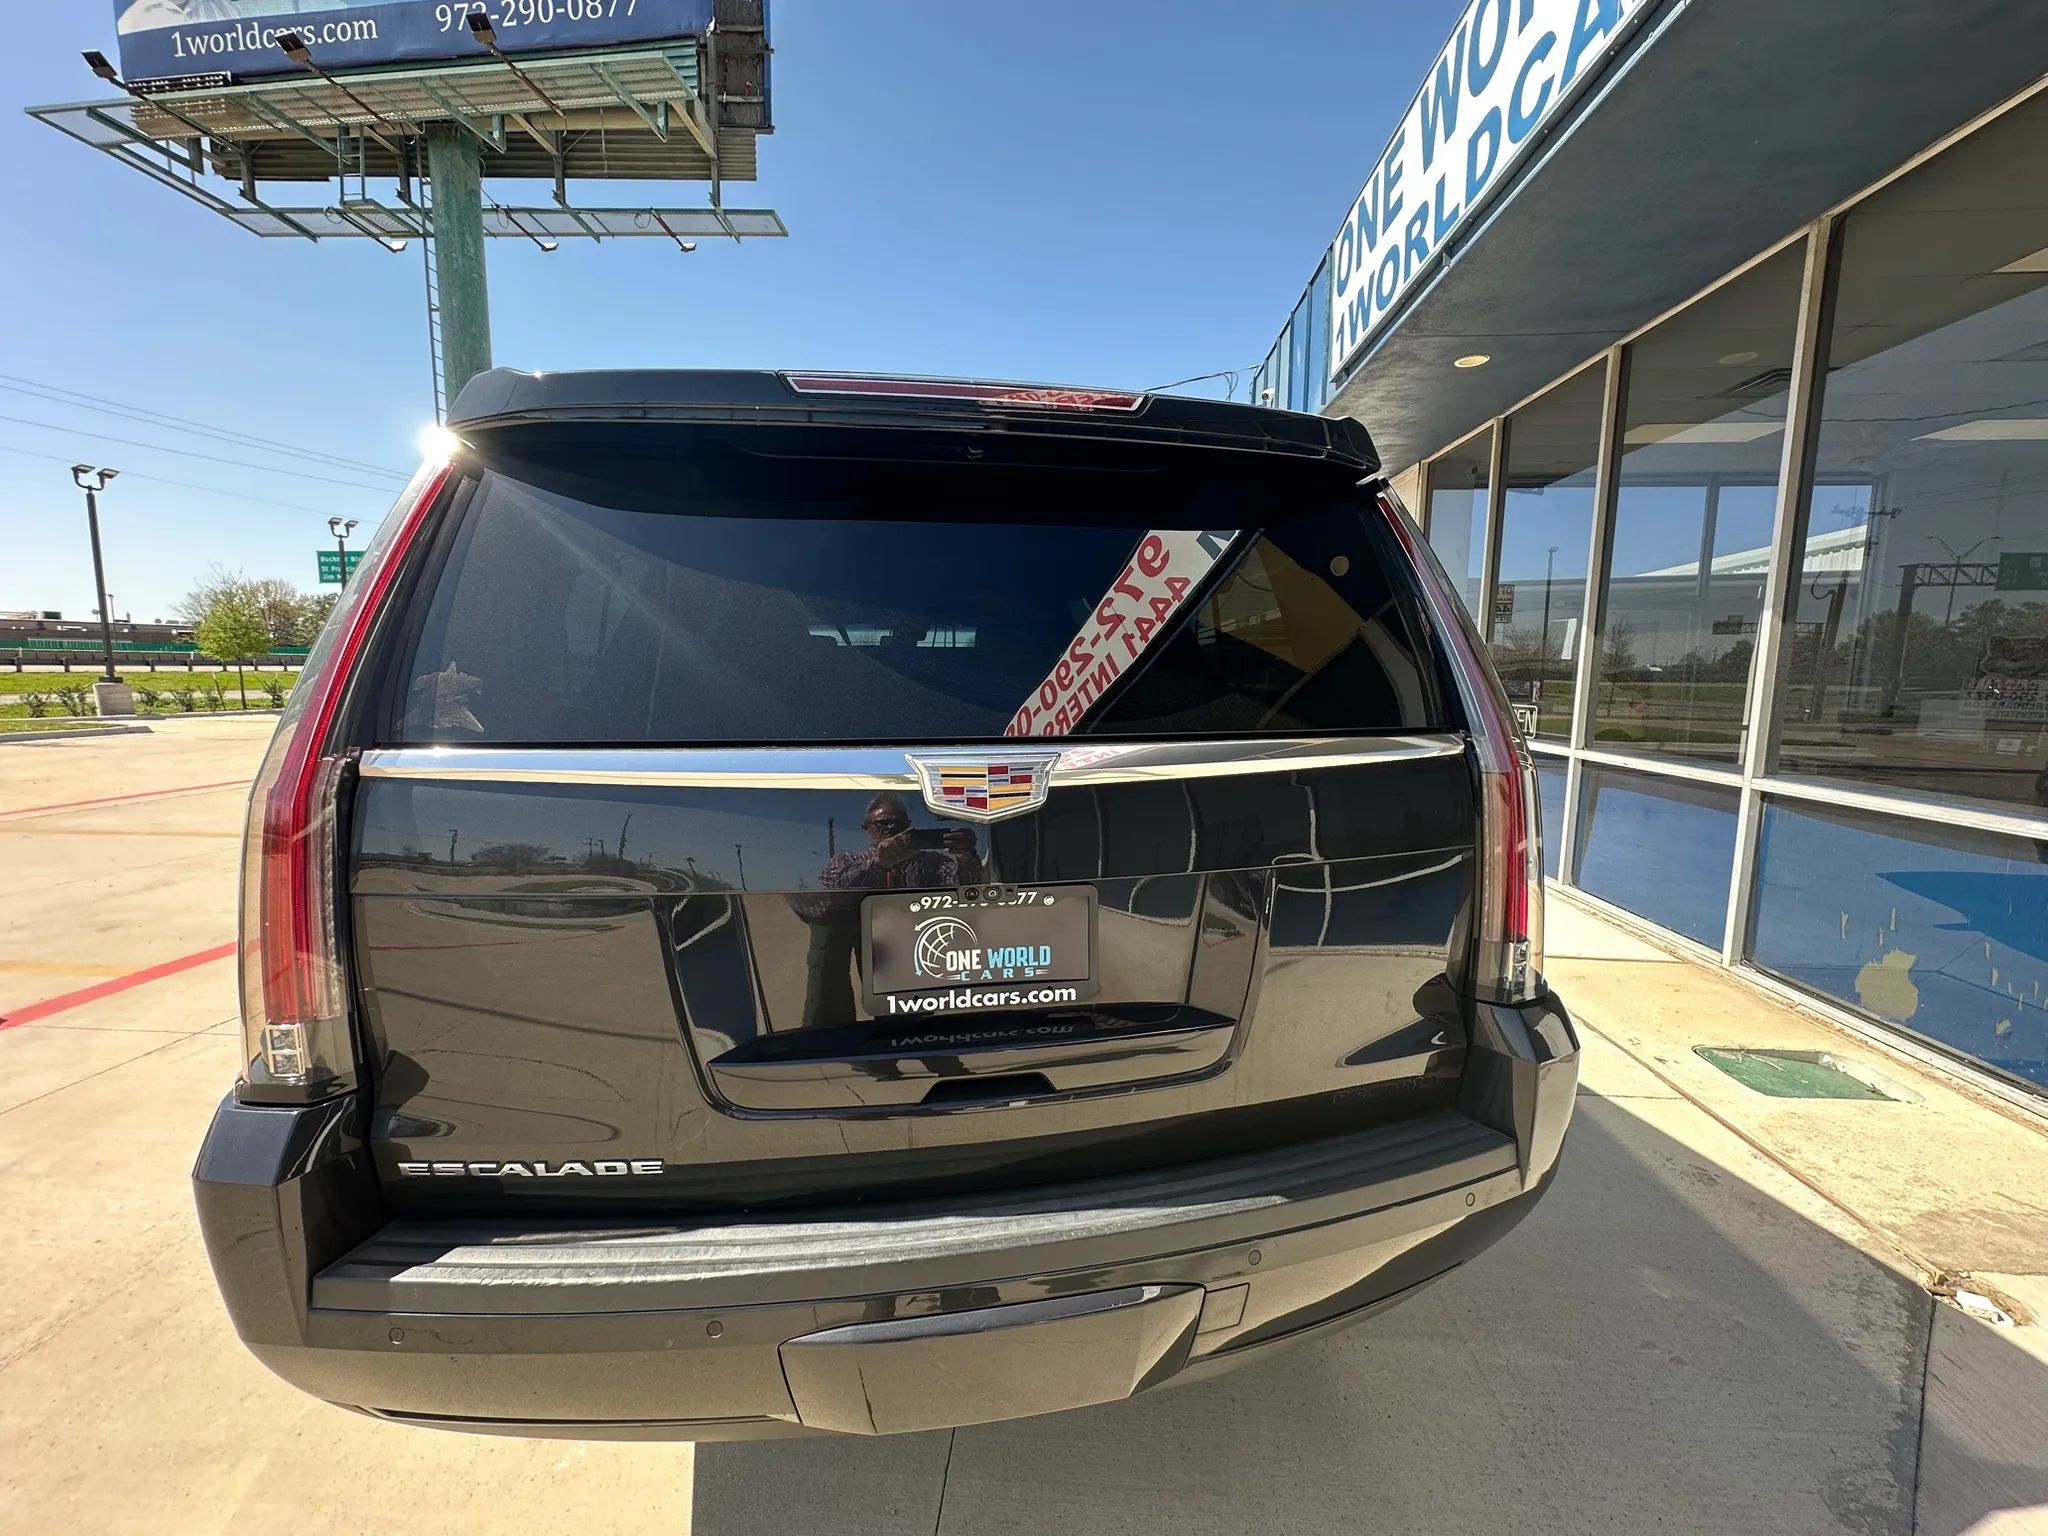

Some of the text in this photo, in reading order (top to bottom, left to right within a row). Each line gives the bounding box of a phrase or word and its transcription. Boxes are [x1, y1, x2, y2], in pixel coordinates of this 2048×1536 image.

[171, 18, 379, 58] 1worldcrs.com
[1336, 0, 1626, 363] 1WORLDCA
[1336, 127, 1405, 298] ONE
[1513, 707, 1536, 734] EN
[946, 945, 1052, 972] ONE WORLD
[959, 966, 1035, 982] CARS
[886, 987, 1077, 1014] 1worldcars.com
[397, 1159, 665, 1177] ESCALADE
